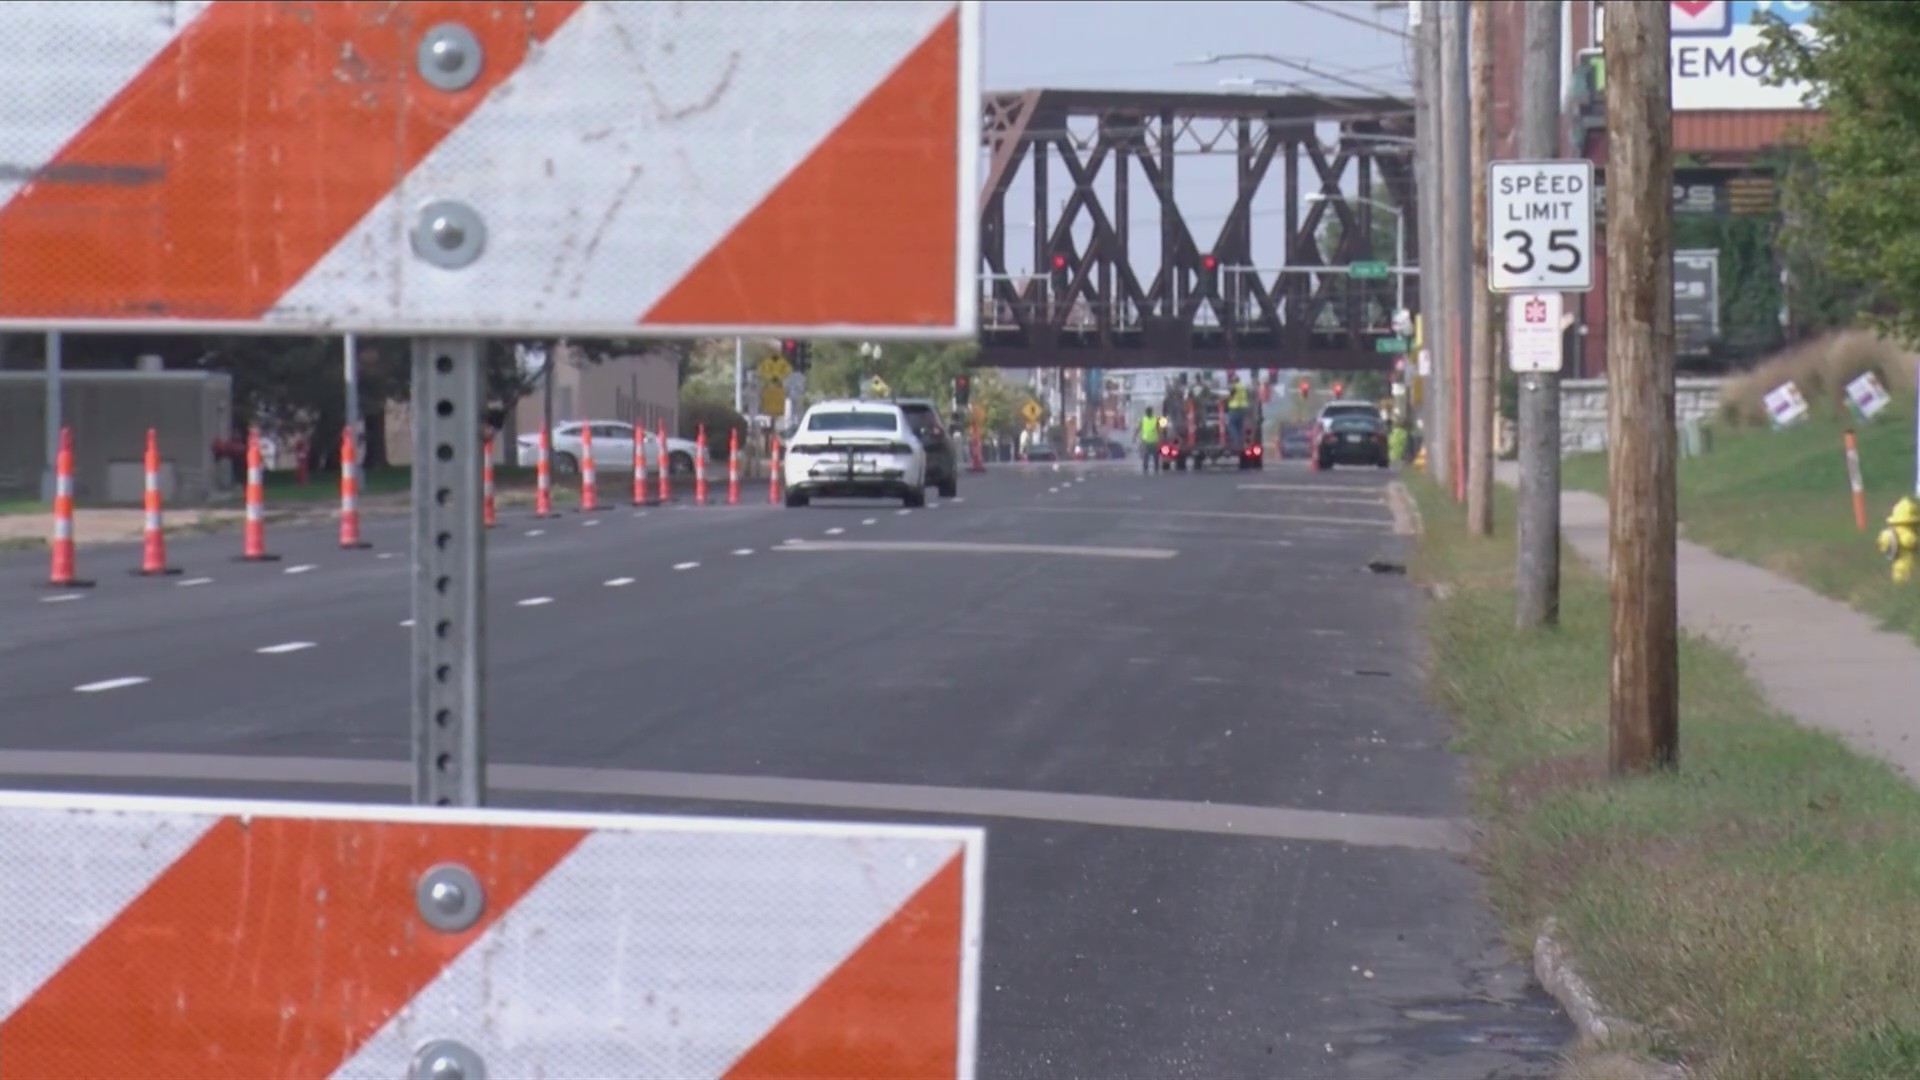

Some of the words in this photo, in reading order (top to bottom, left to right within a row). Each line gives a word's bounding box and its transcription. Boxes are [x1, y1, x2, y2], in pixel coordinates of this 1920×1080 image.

[1672, 46, 1768, 78] EMO
[1500, 175, 1583, 195] SPEED
[1508, 202, 1573, 221] LIMIT
[1502, 229, 1582, 274] 35
